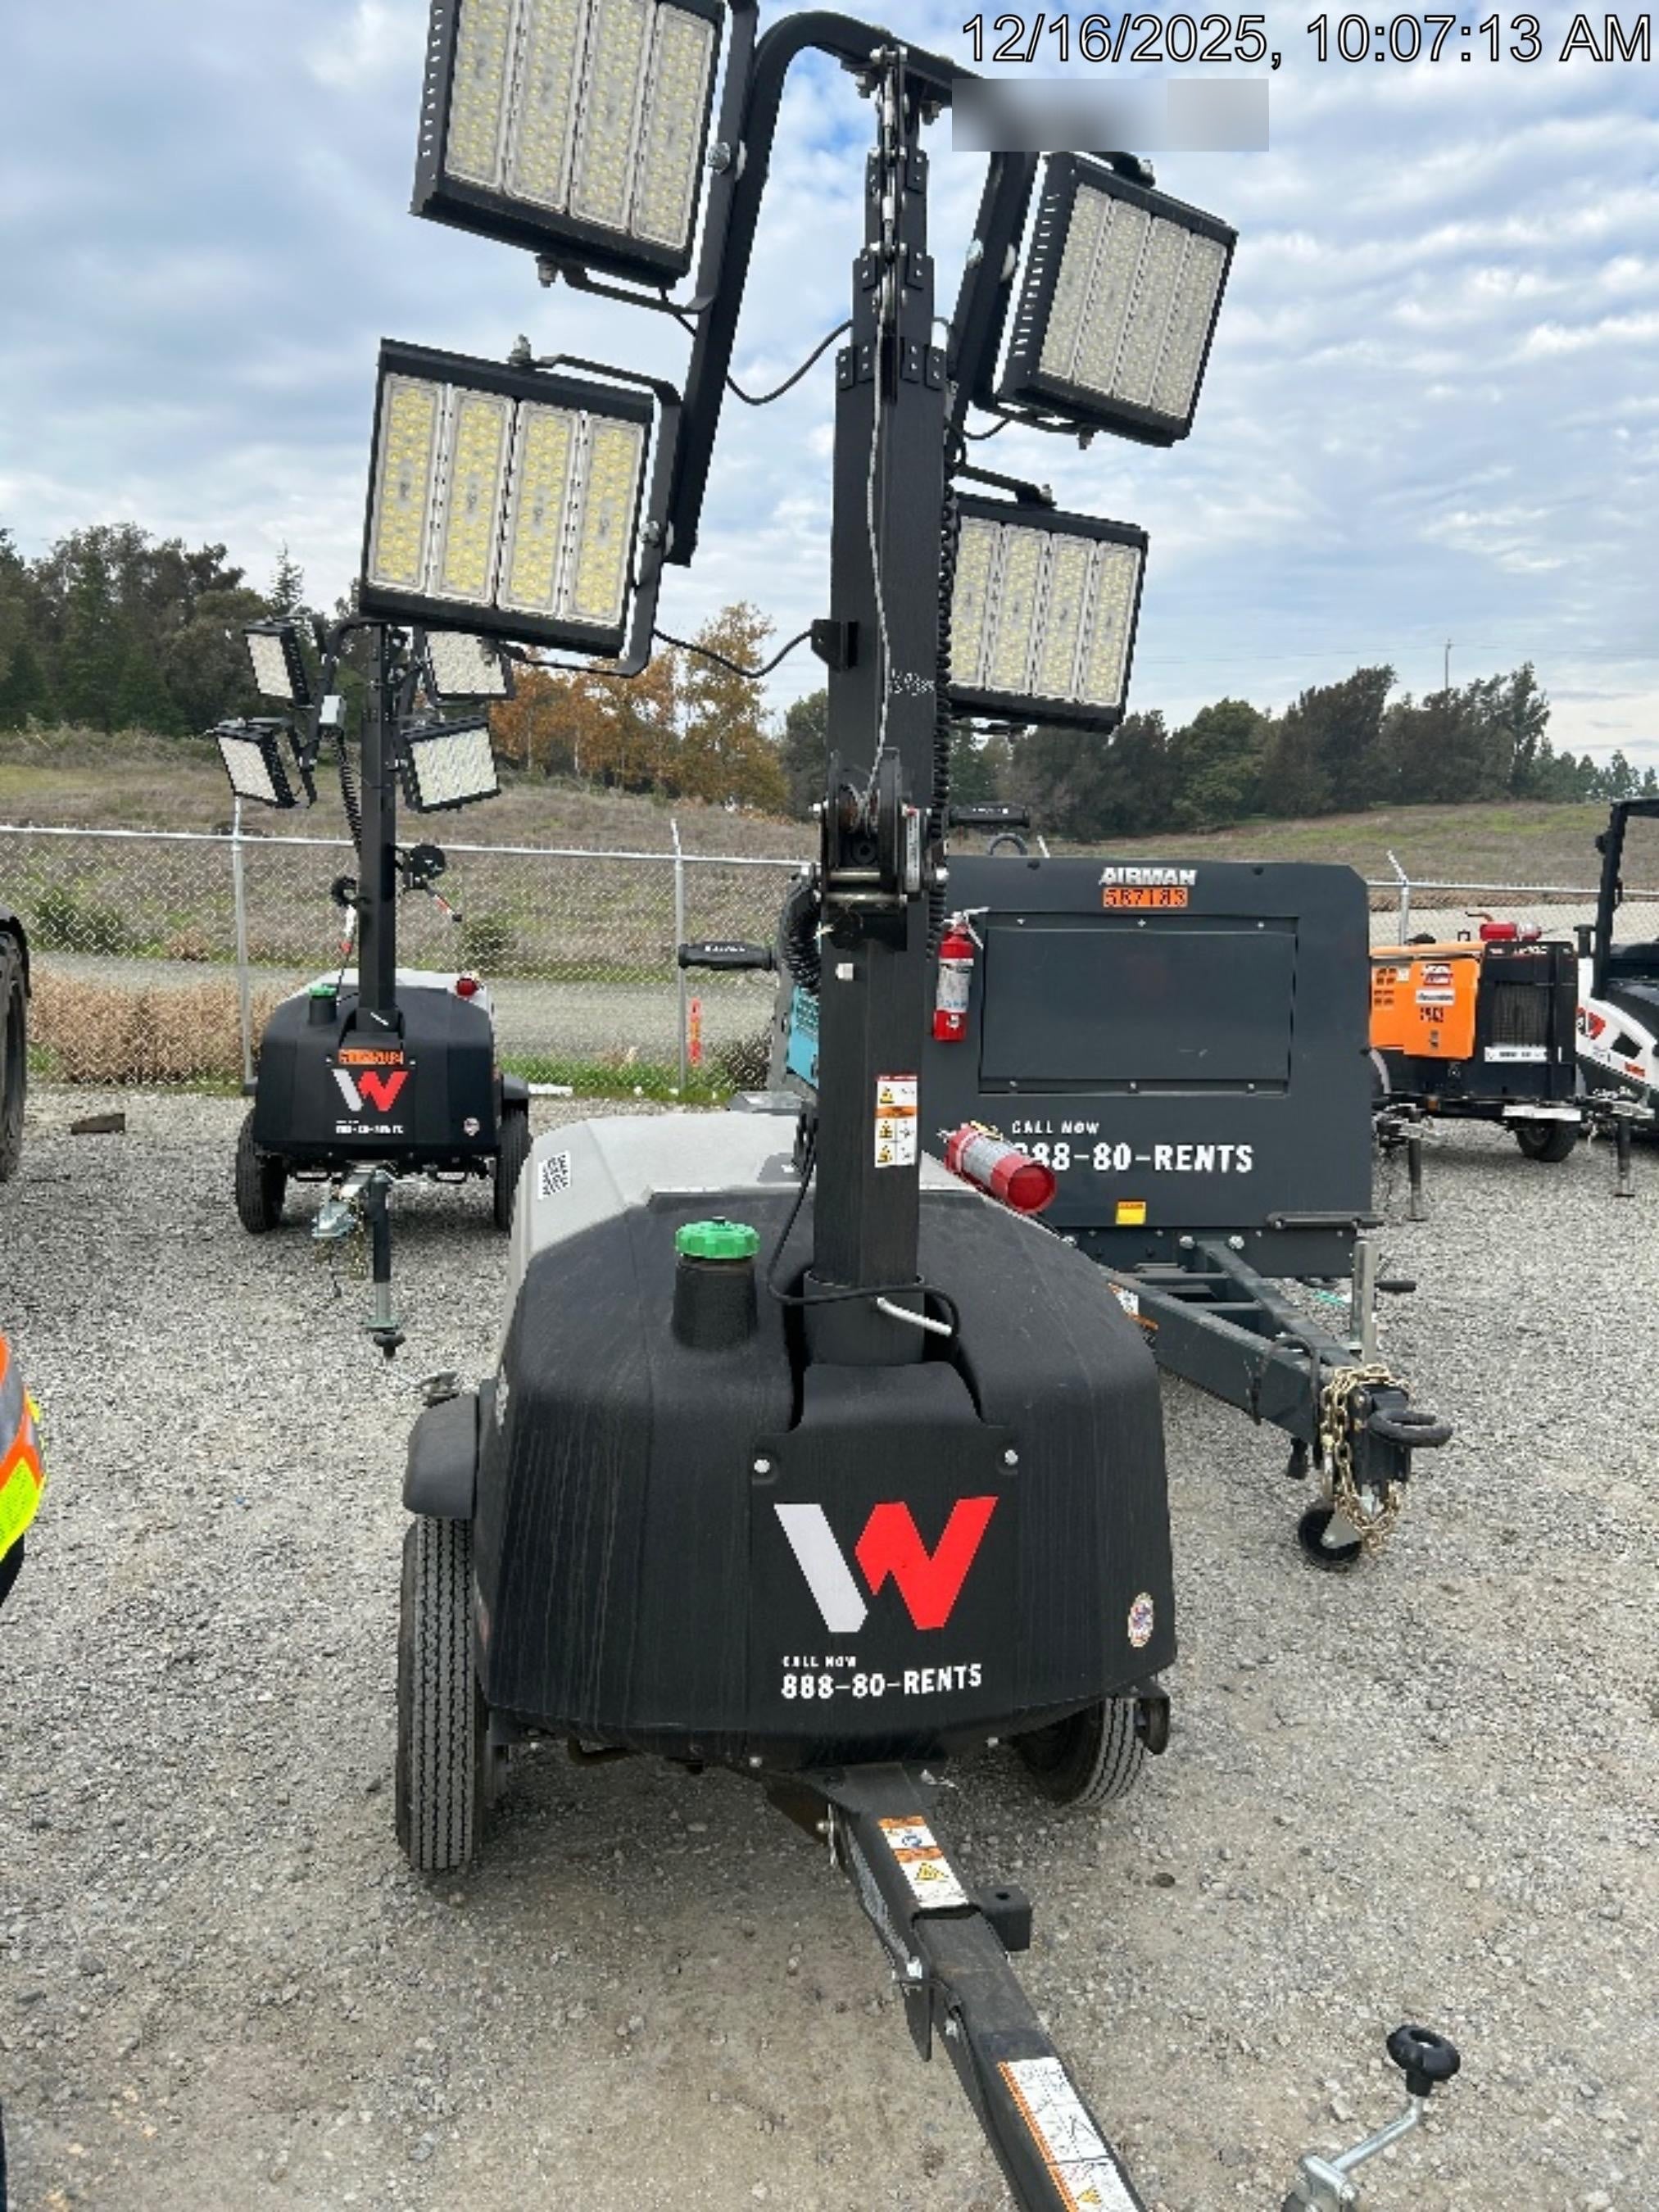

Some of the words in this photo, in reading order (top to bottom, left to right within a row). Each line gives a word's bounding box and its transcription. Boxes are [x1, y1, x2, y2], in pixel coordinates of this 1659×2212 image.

[1099, 867, 1197, 886] AIRMAN
[1011, 1119, 1054, 1135] CALL
[1061, 1120, 1100, 1135] NOW
[782, 1655, 819, 1668] CALL
[824, 1655, 857, 1668] NOW
[781, 1662, 982, 1700] 888-80-RENTS
